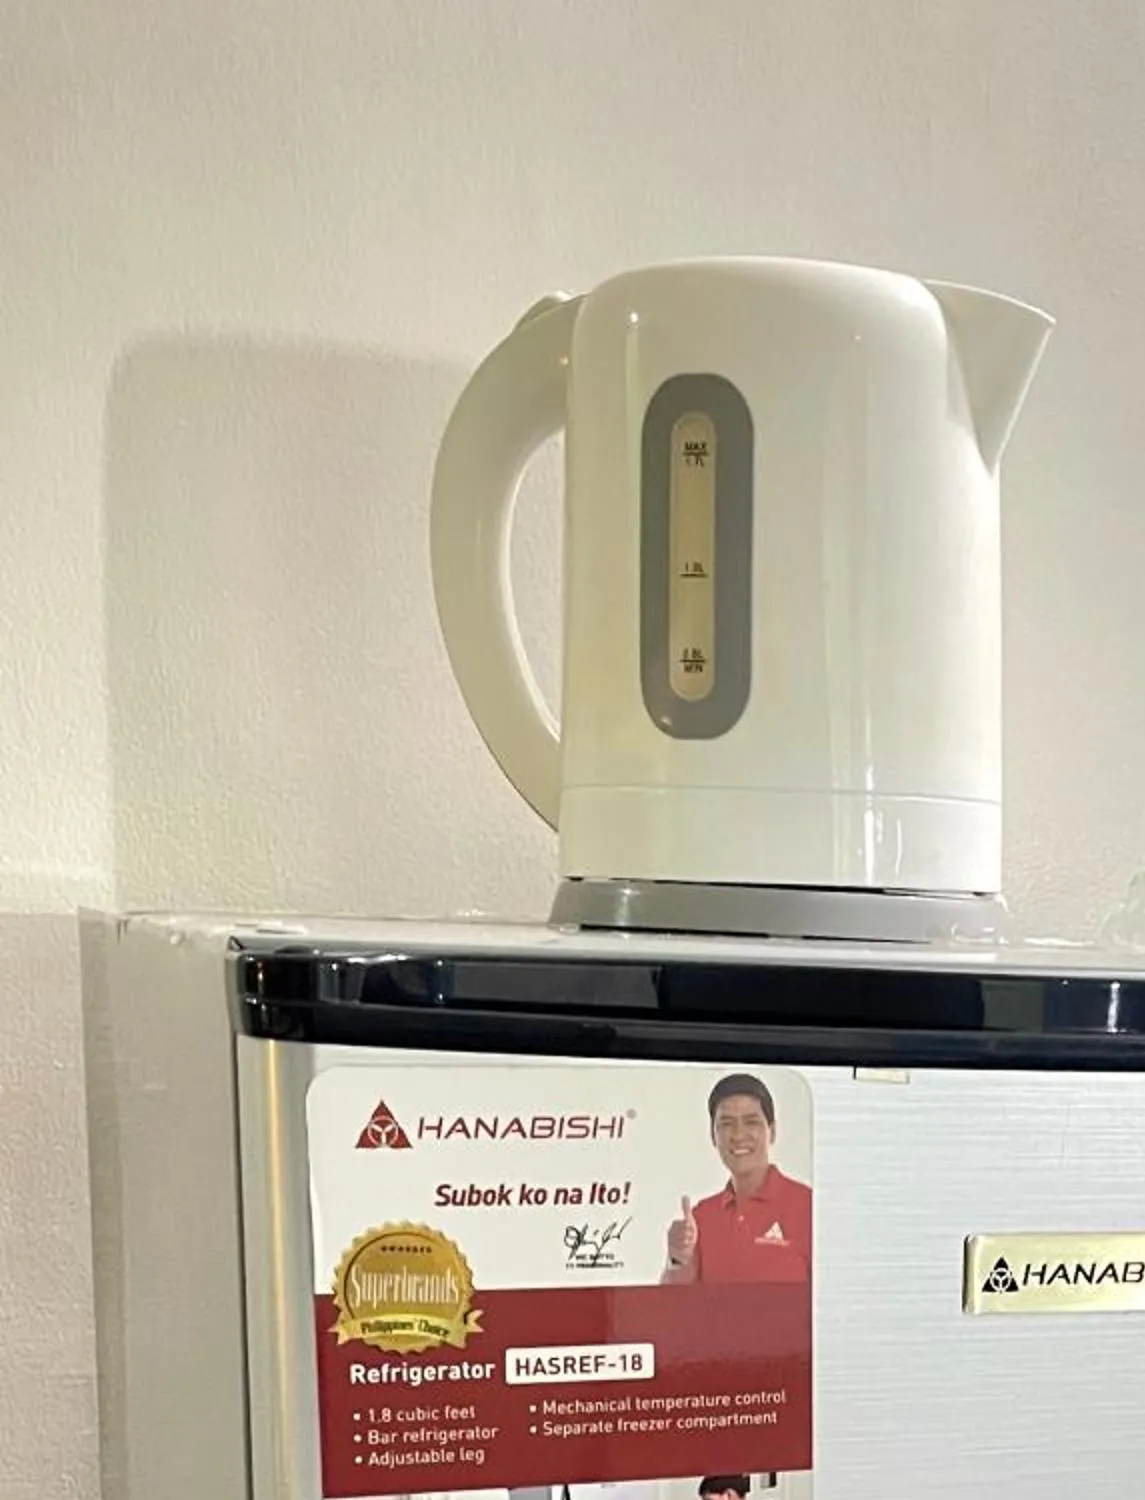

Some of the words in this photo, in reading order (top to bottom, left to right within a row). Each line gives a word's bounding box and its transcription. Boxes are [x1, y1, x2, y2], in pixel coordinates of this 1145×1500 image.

[417, 1114, 626, 1140] HANABISHI
[435, 1184, 511, 1208] Subok
[519, 1184, 547, 1207] ko
[554, 1188, 583, 1206] na
[351, 1264, 460, 1309] Superbrands
[350, 1360, 495, 1385] Refrigerator
[515, 1353, 643, 1376] HASREF-18
[397, 1406, 438, 1422] cubic
[444, 1405, 476, 1420] feet
[542, 1396, 632, 1416] Mechanical
[636, 1393, 731, 1412] temperature
[735, 1389, 786, 1406] control
[368, 1430, 397, 1445] Bar
[403, 1424, 499, 1445] refrigerator
[543, 1418, 613, 1438] Separate
[617, 1414, 671, 1432] freezer
[677, 1411, 777, 1431] compartment
[369, 1447, 454, 1468] Adjustable
[460, 1446, 485, 1466] leg
